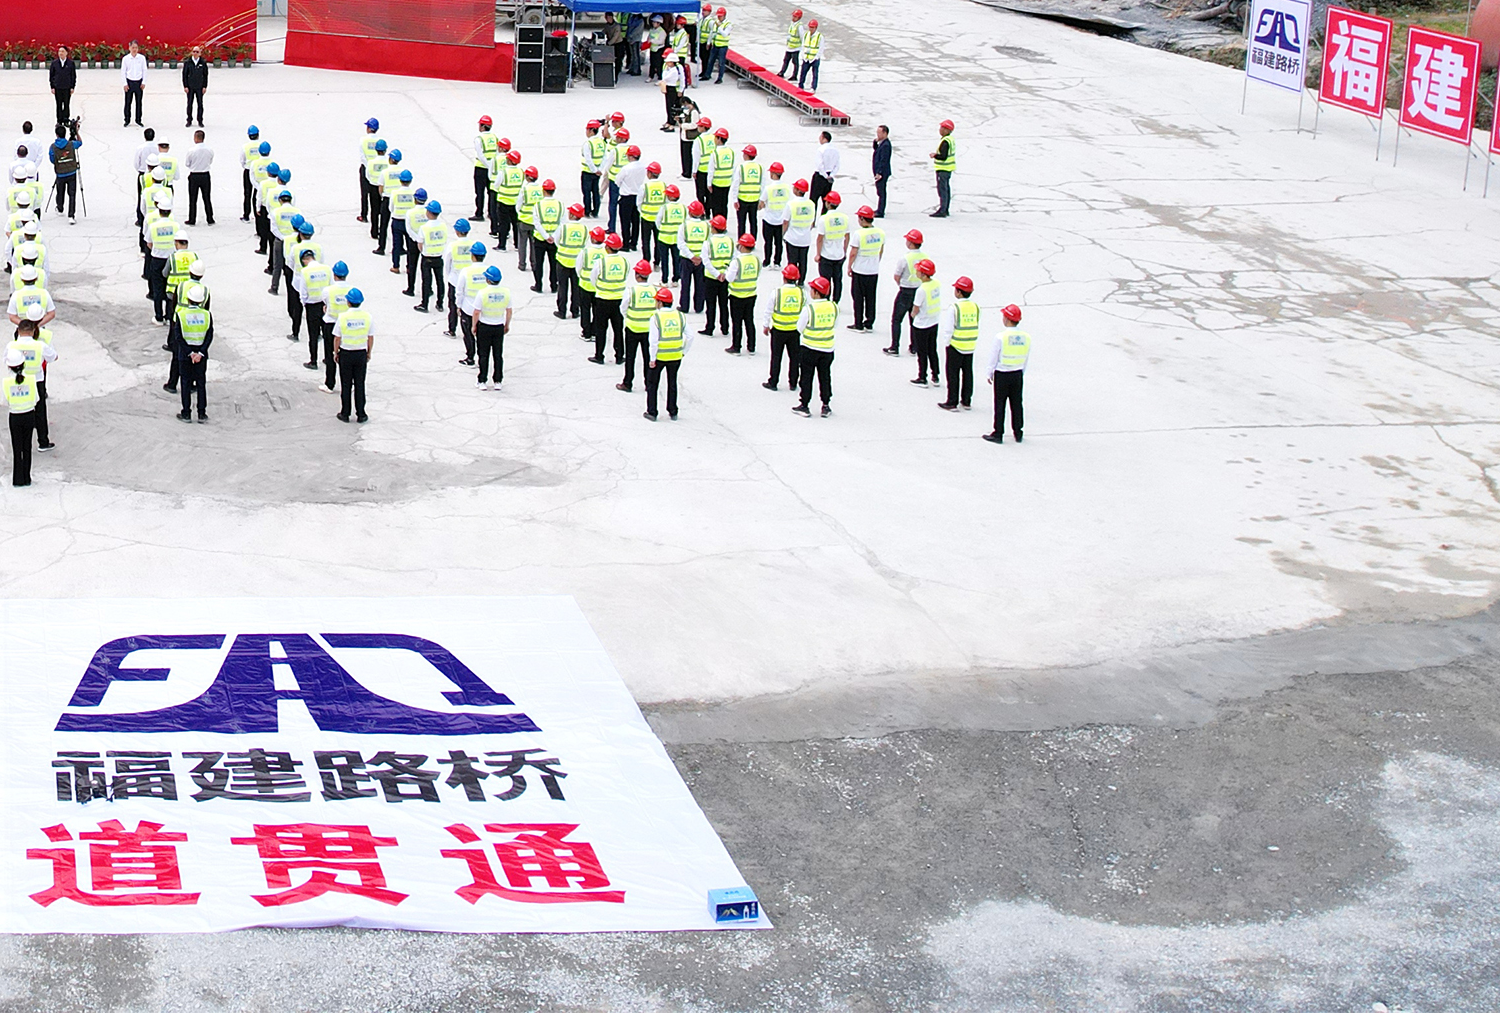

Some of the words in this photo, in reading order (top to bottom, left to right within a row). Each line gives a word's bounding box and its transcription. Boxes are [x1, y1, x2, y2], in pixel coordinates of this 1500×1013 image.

[1252, 46, 1300, 76] 福建路桥
[52, 748, 566, 806] 福建路桥
